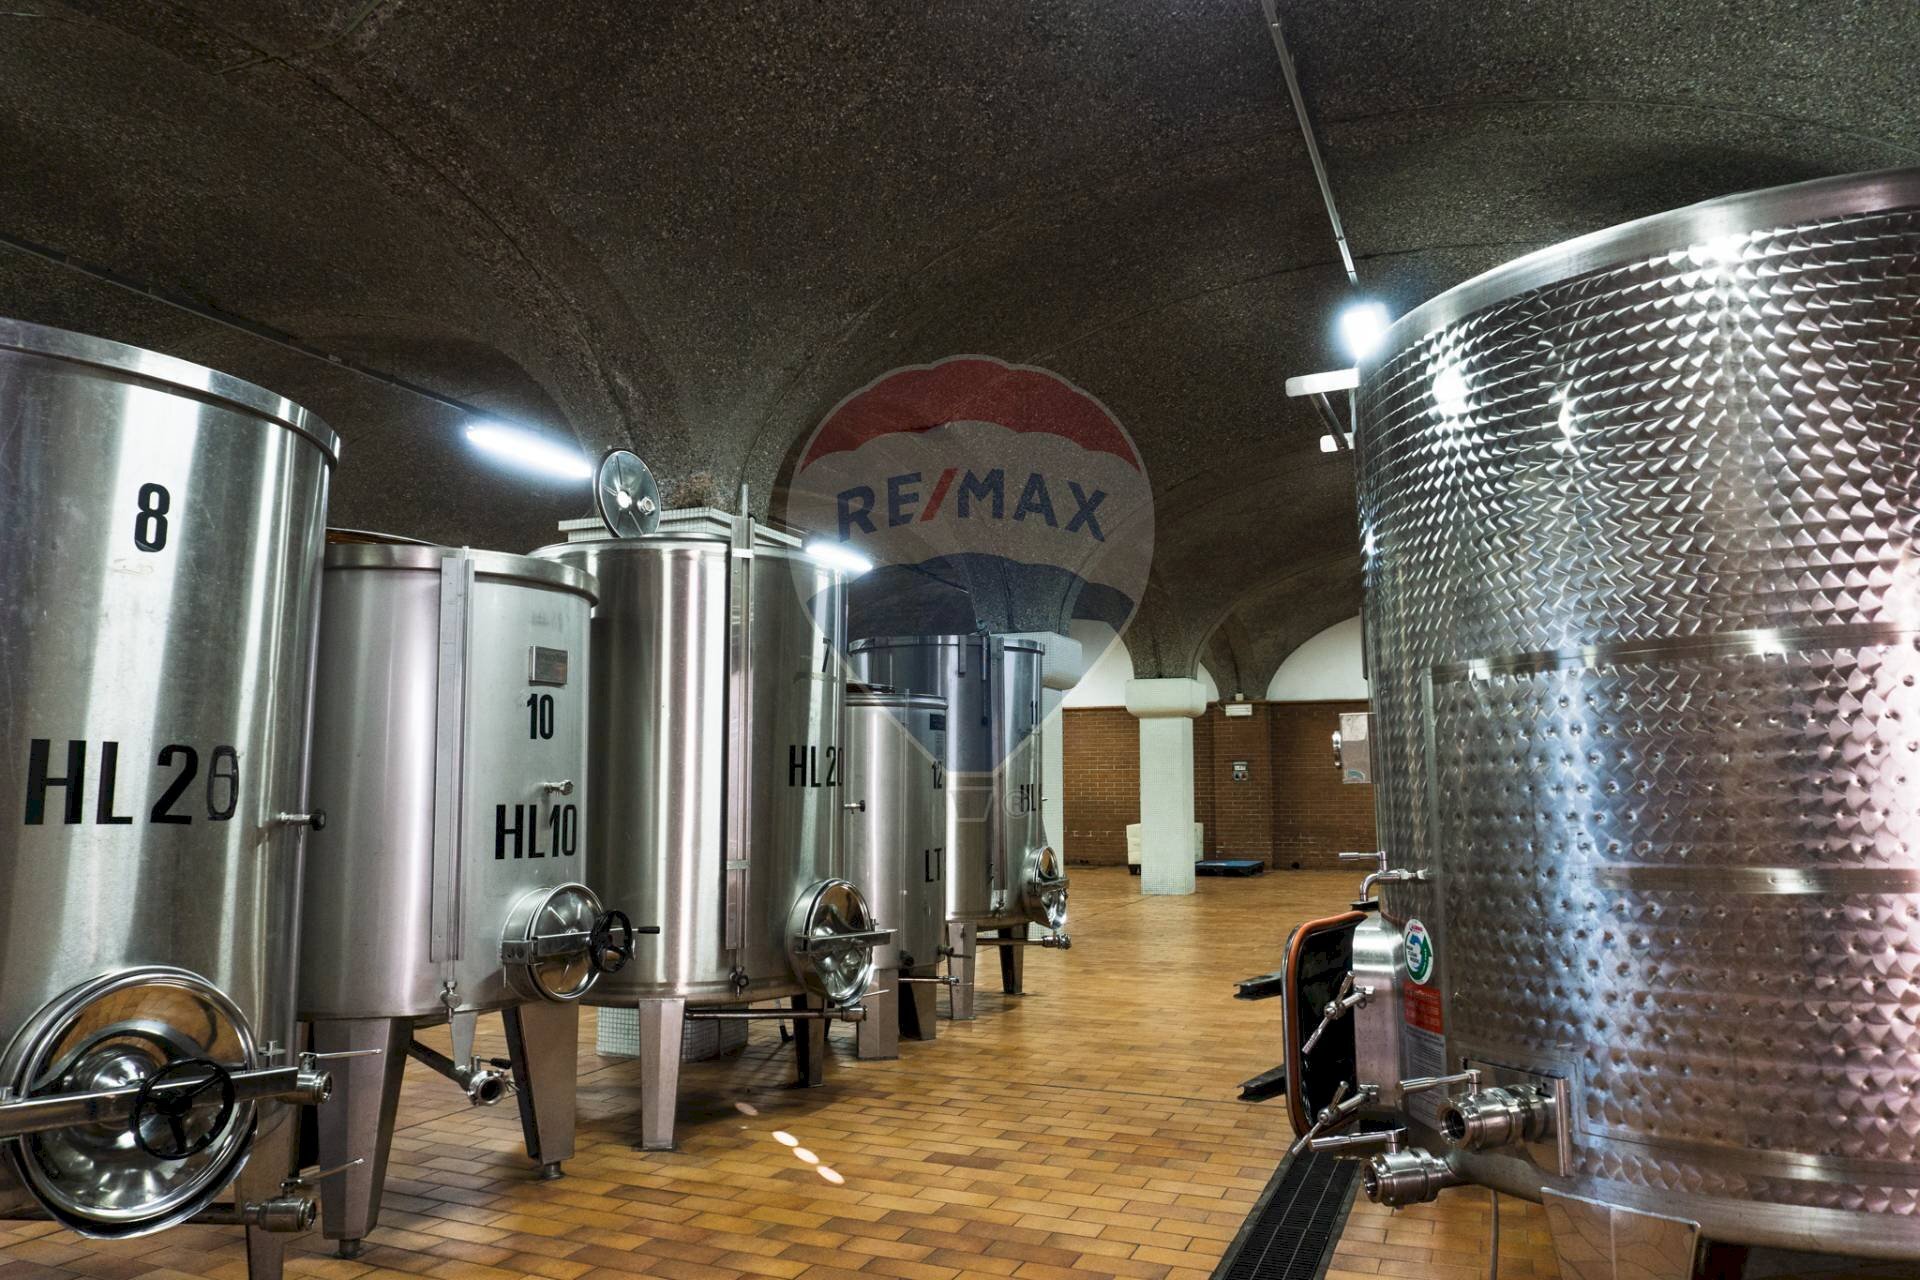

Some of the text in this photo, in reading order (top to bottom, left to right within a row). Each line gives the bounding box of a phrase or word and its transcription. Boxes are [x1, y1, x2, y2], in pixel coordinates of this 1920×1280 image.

[135, 482, 170, 552] 8
[822, 637, 832, 672] 7
[527, 693, 554, 740] 10
[932, 761, 943, 789] 12
[925, 847, 947, 883] LT
